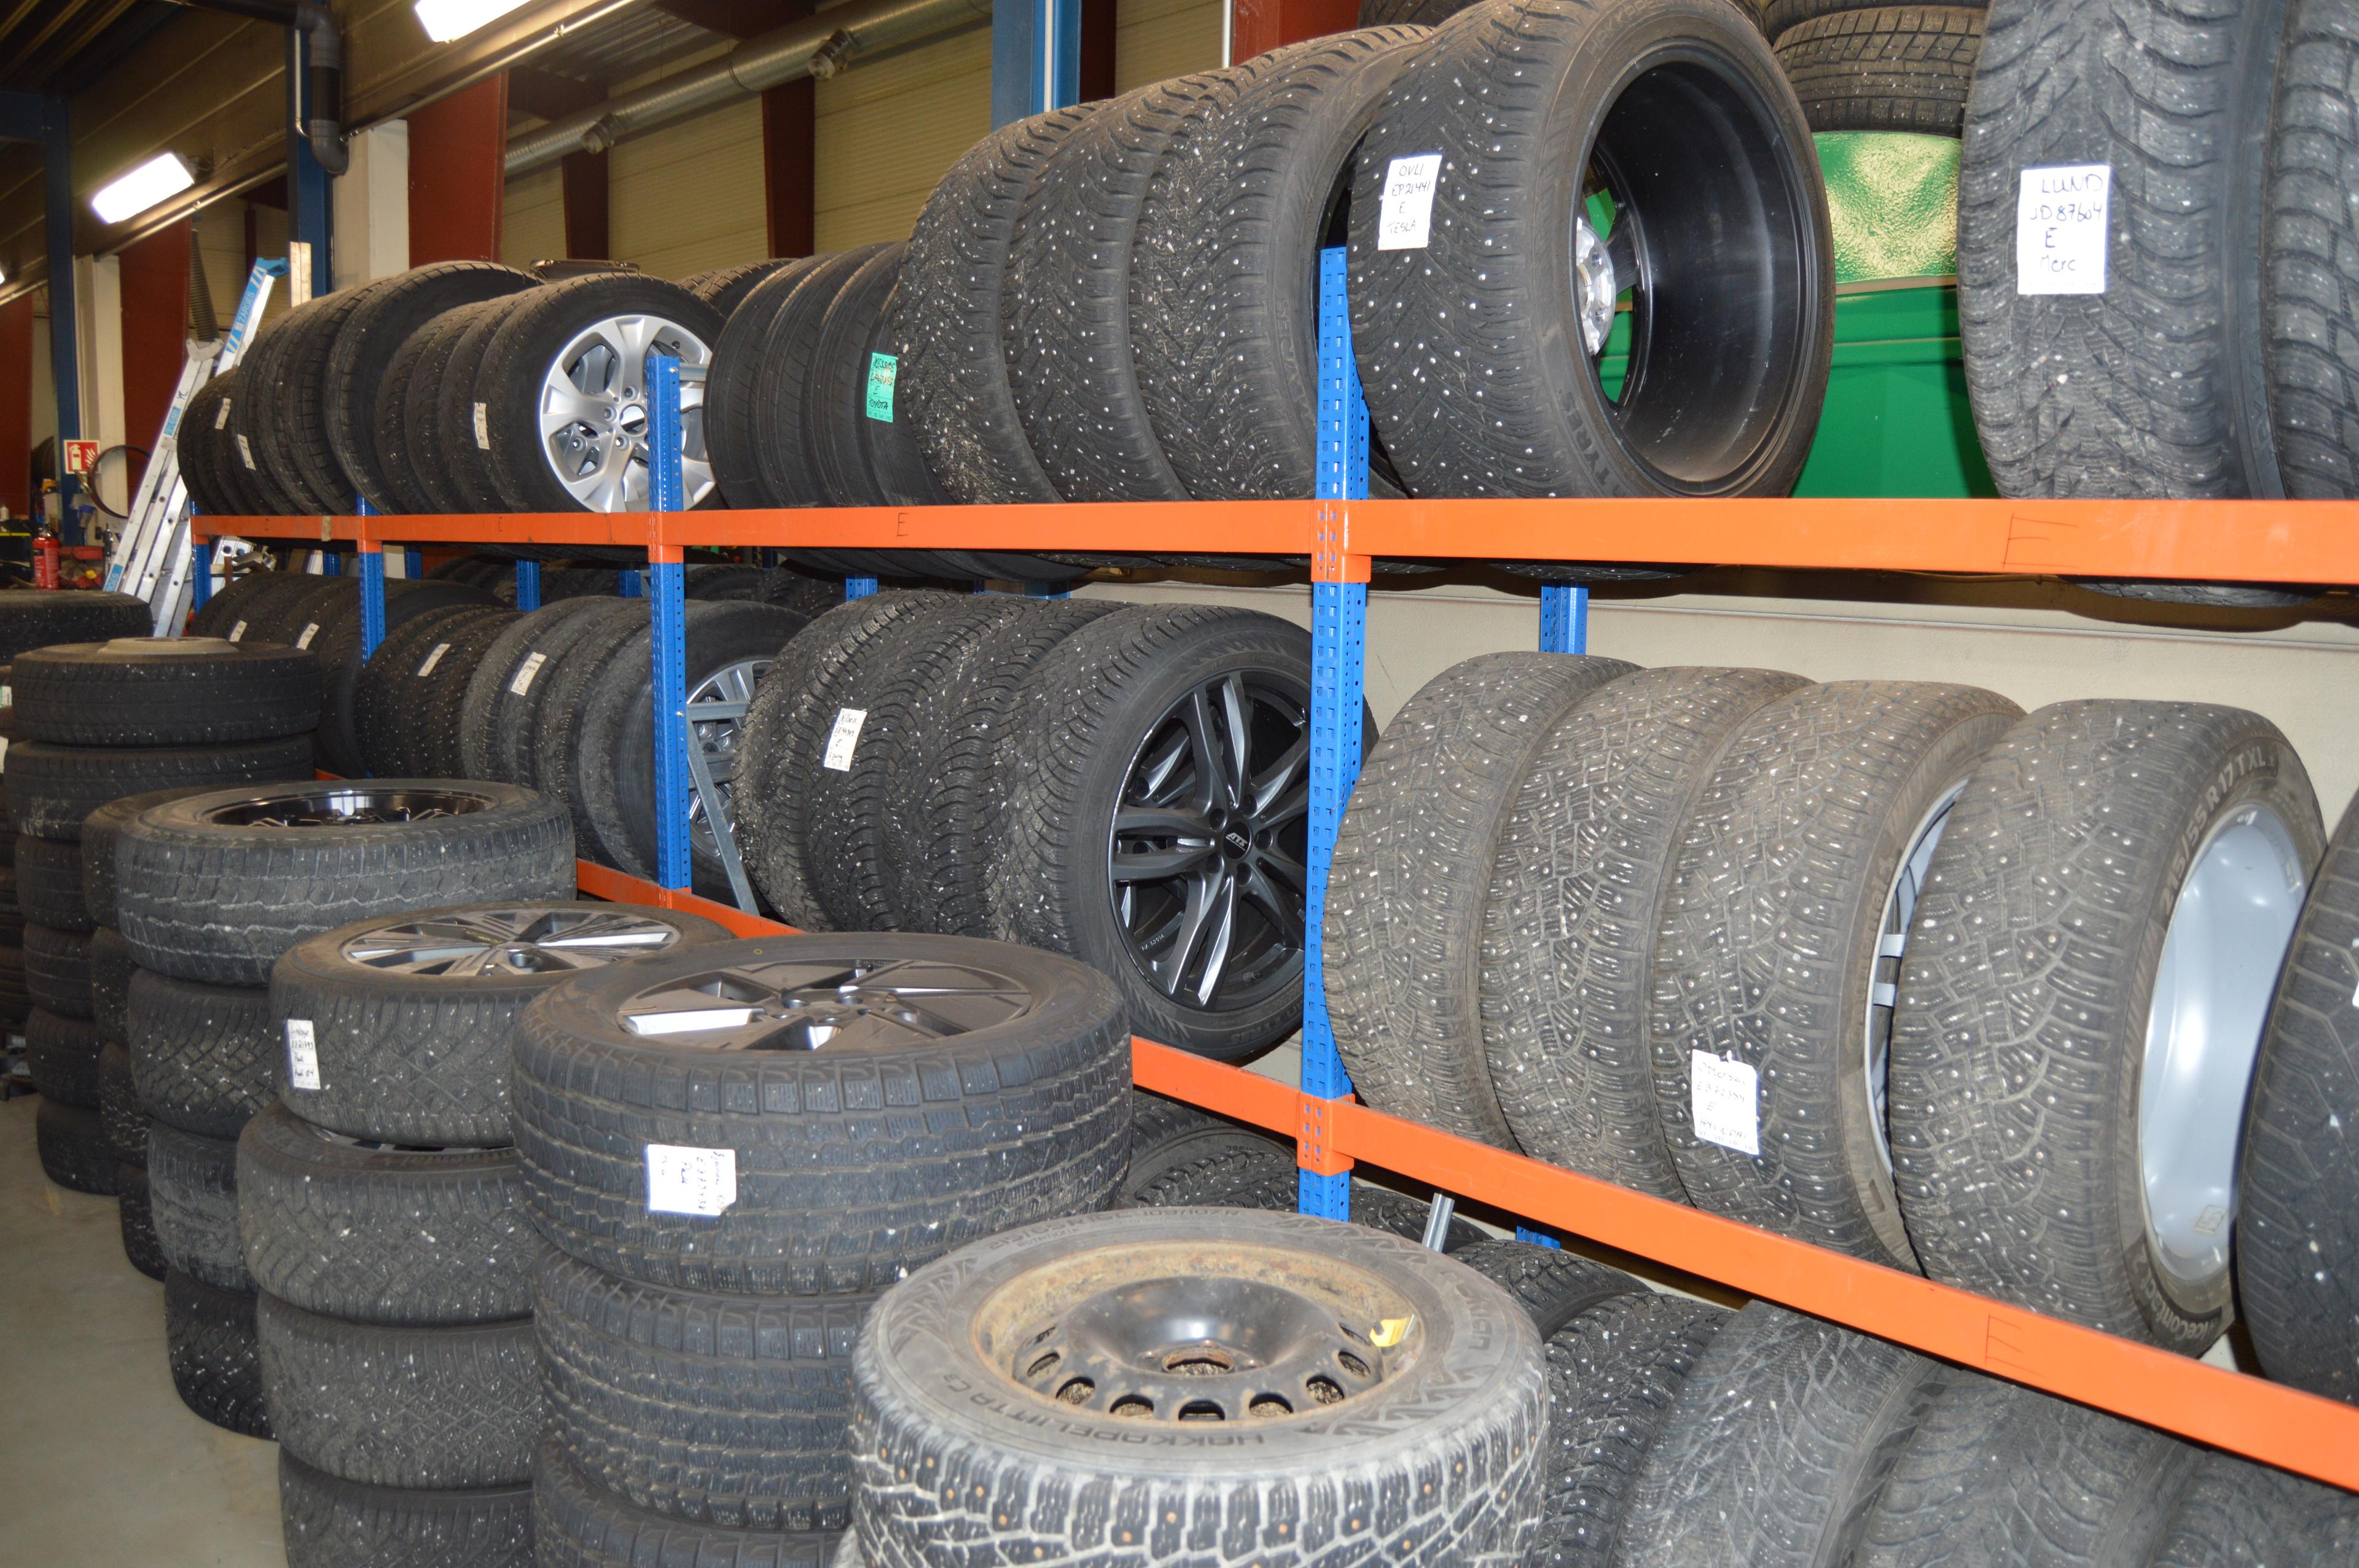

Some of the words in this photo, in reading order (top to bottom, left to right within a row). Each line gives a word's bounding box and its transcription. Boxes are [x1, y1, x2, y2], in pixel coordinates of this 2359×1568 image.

[2041, 174, 2103, 193] LUND
[1399, 201, 1406, 213] E
[1387, 219, 1416, 234] TESLA
[2044, 227, 2058, 248] E
[2040, 254, 2076, 273] Merc
[868, 399, 889, 411] TOYOTA
[1226, 832, 1248, 848] ATS
